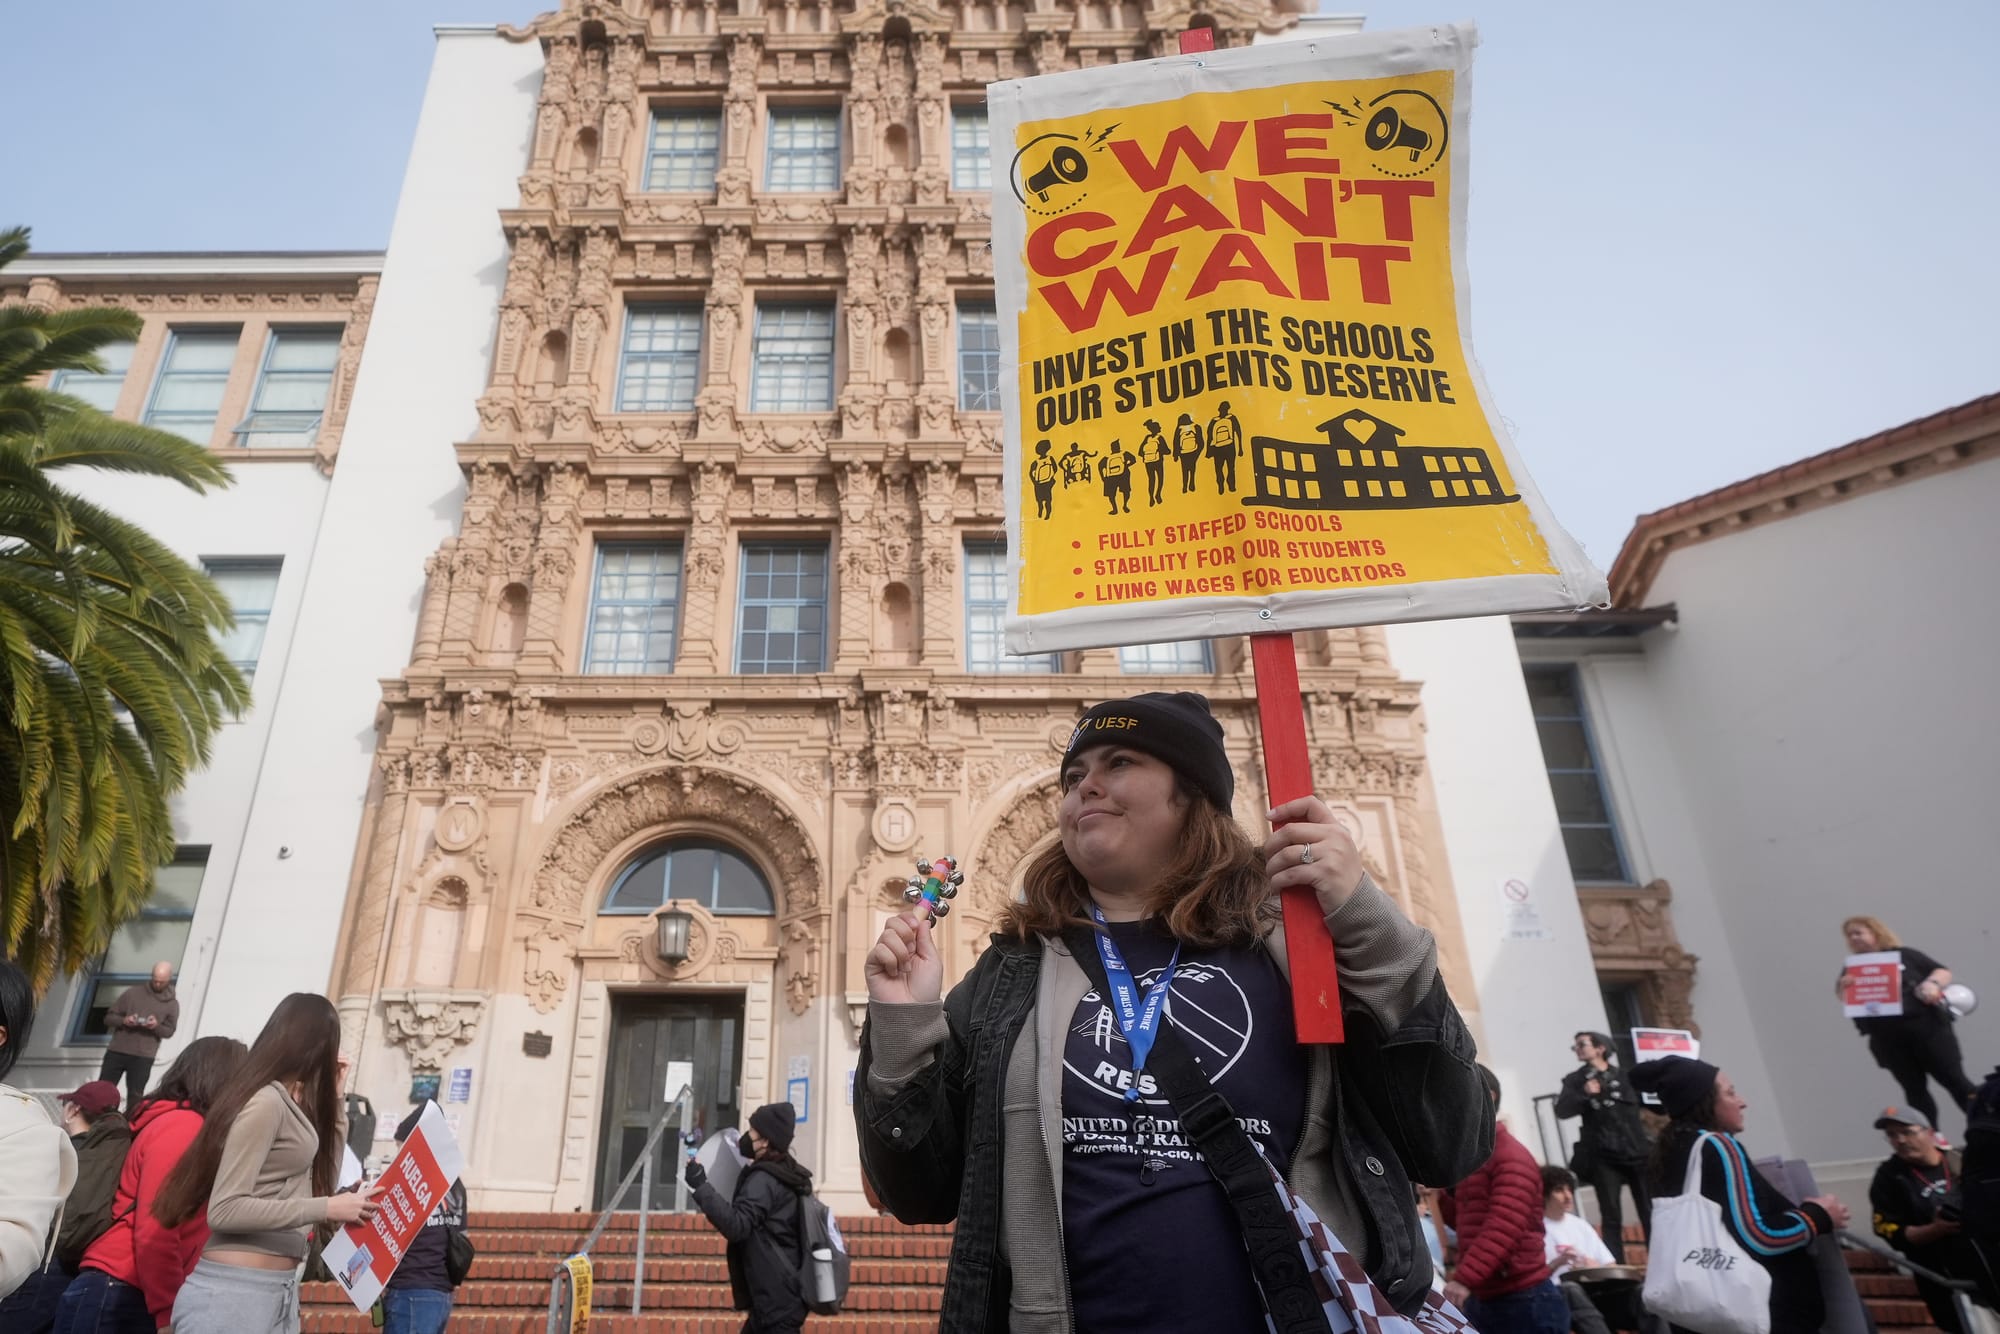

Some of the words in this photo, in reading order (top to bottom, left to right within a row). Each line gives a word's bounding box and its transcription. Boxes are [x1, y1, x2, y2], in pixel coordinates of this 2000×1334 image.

[1107, 113, 1340, 193] WE
[1027, 178, 1434, 278] CAN'T
[1038, 233, 1411, 334] WAIT
[1033, 332, 1147, 394] INVEST
[1162, 326, 1194, 360] IN
[1206, 308, 1273, 346] THE
[1282, 317, 1434, 363] SCHOOLS
[1036, 385, 1102, 433] OUR
[1114, 350, 1292, 413] STUDENTS
[1304, 360, 1455, 405] DESERVE
[1098, 528, 1156, 551] FULLY
[1164, 513, 1247, 544] STAFFED
[1255, 511, 1343, 533] SCHOOLS
[1094, 554, 1187, 576] STABILITY
[1197, 547, 1237, 569] FOR
[1242, 540, 1281, 559] OUR
[1287, 539, 1386, 559] STUDENTS
[1095, 582, 1158, 601] LIVING
[1165, 575, 1235, 596] WAGES
[1242, 568, 1283, 589] FOR
[1289, 562, 1406, 584] EDUCATORS
[1095, 717, 1138, 730] UESF
[888, 814, 905, 837] H
[1118, 985, 1132, 1008] STRIKE
[1124, 1006, 1135, 1018] ON
[1150, 996, 1159, 1007] ON
[1140, 1006, 1156, 1031] STRIKE
[1062, 1117, 1128, 1133] NITED
[400, 1152, 433, 1212] HUELGA
